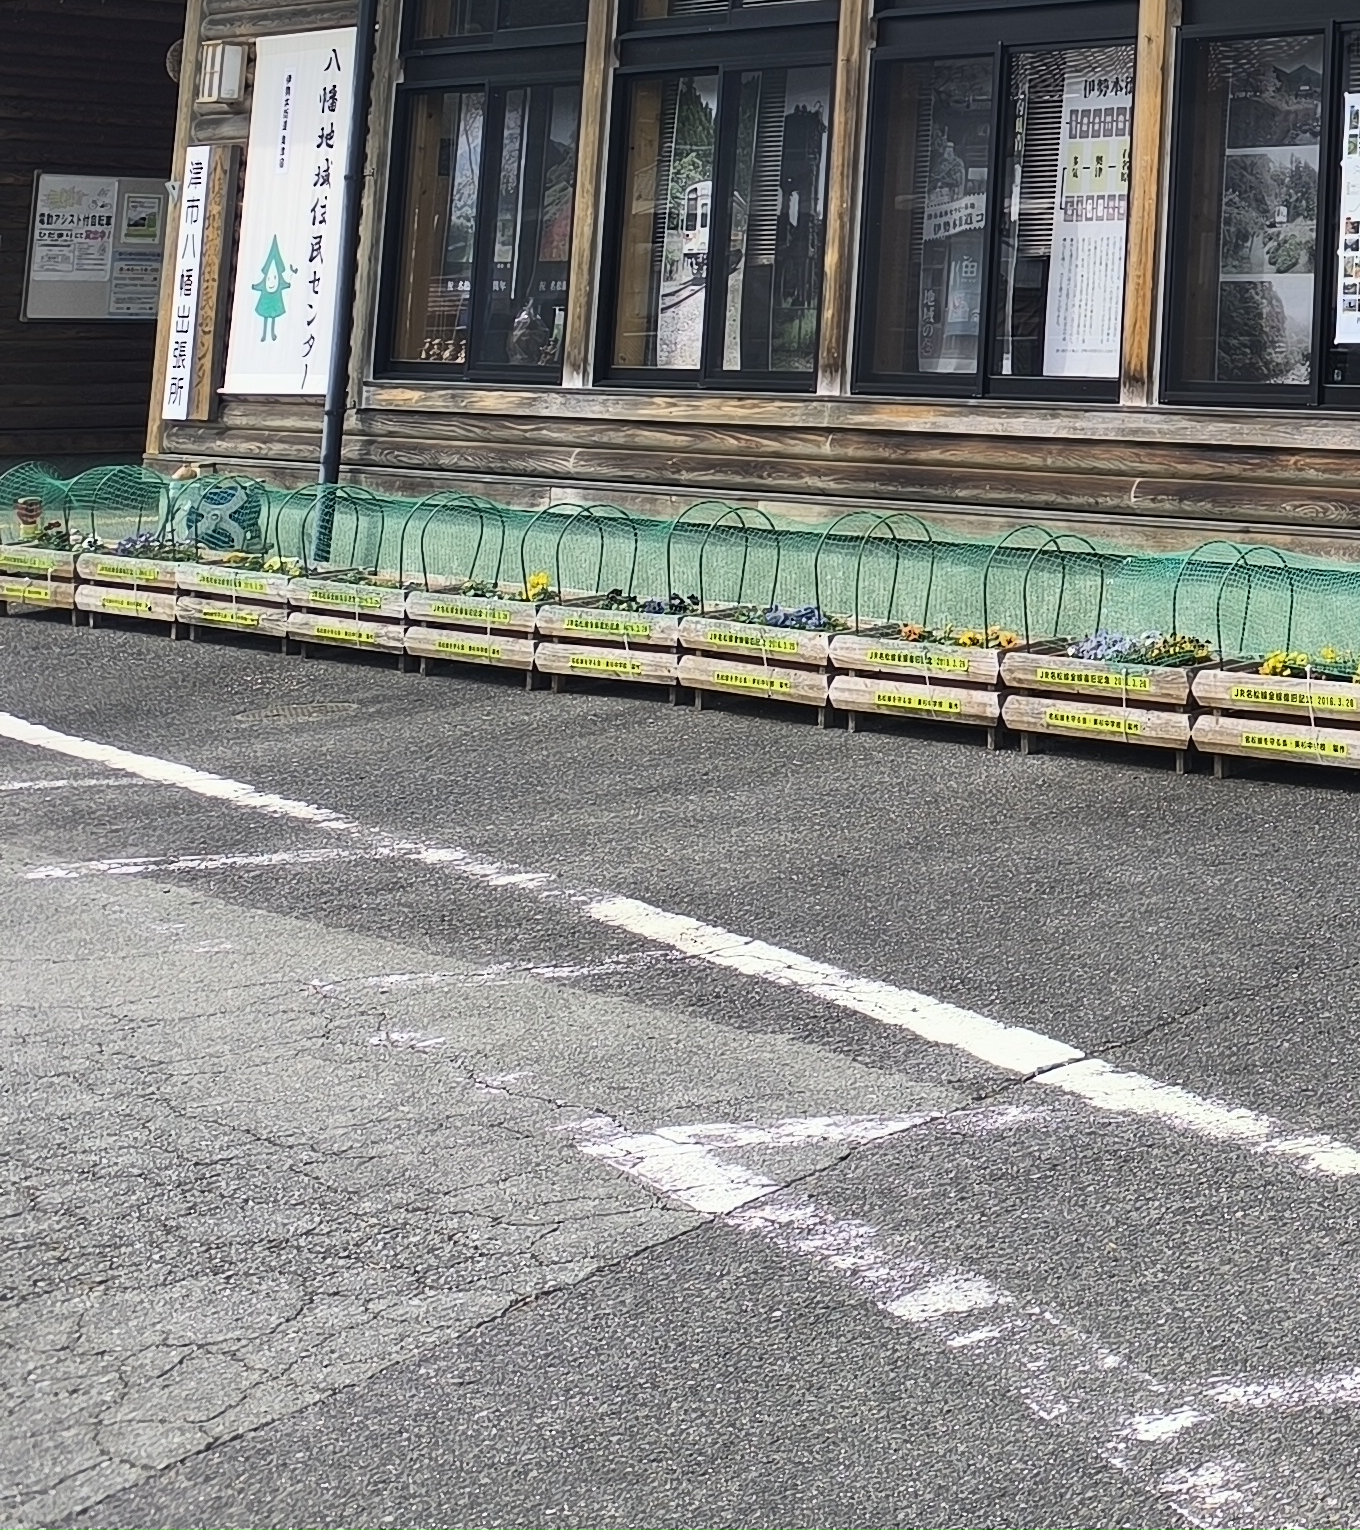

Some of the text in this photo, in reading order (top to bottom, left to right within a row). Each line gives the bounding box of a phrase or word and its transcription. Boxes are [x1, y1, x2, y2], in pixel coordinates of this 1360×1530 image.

[168, 159, 204, 406] 津市八幡出張所
[301, 48, 341, 390] 八幡地域住民センター
